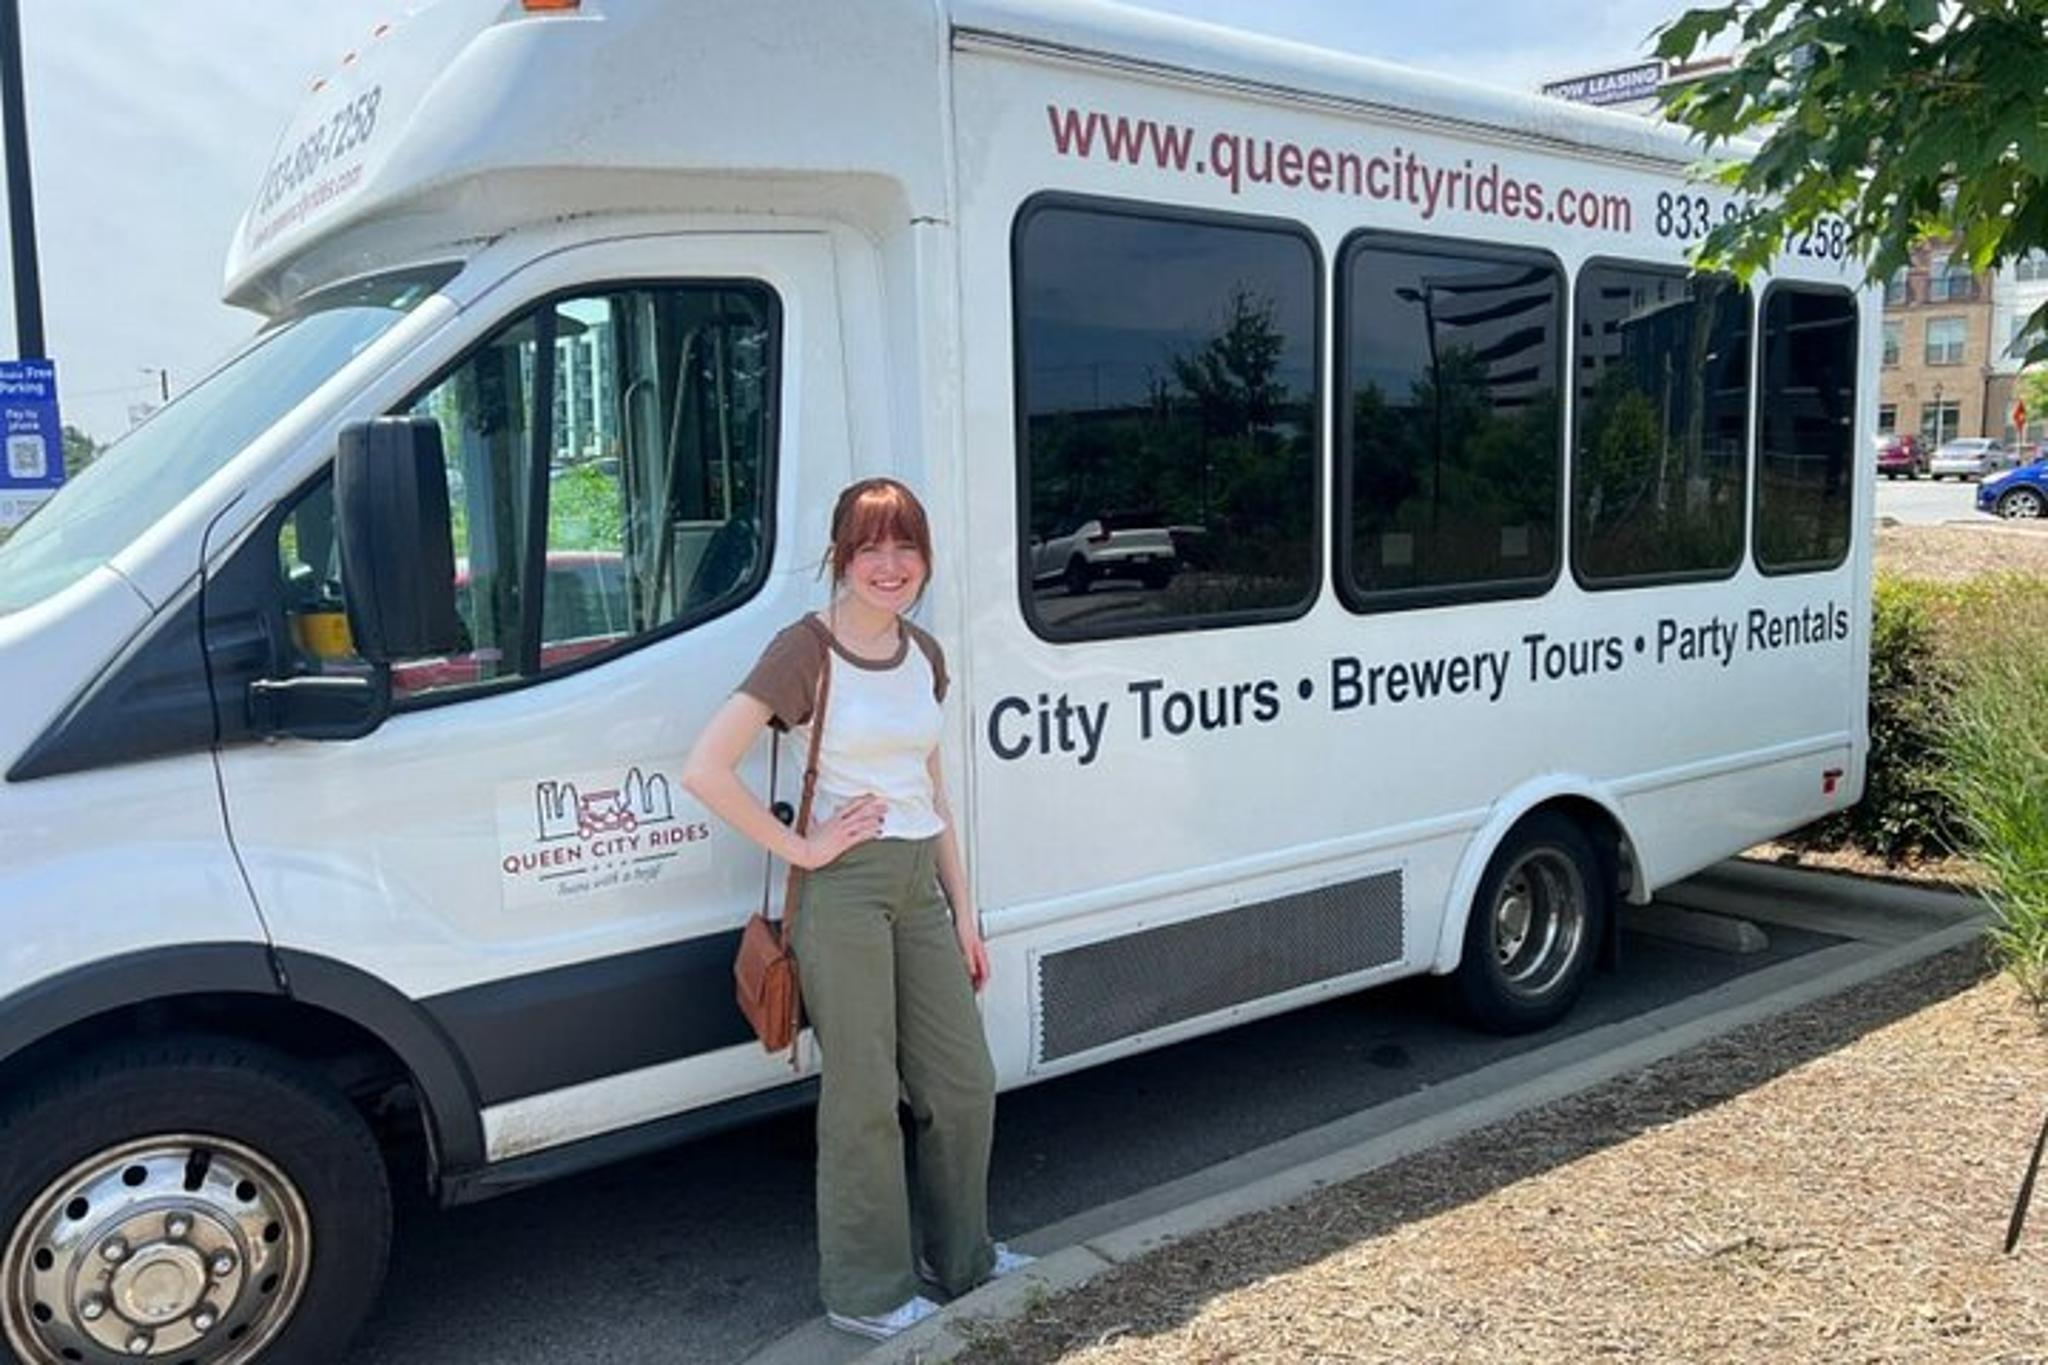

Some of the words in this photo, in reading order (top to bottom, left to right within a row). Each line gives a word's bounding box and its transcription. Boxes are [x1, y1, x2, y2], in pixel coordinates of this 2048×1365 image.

[1588, 69, 1658, 94] LEASING
[1047, 104, 1633, 233] www.queencityrides.com
[987, 693, 1109, 766] City
[1128, 678, 1280, 740] Tours
[1331, 655, 1510, 711] Brewery
[1522, 632, 1624, 683] Tours
[1656, 615, 1739, 668] Party
[1746, 601, 1850, 652] Rentals
[502, 844, 582, 875] QUEEN
[591, 835, 641, 857] CITY
[650, 823, 710, 847] RIDES
